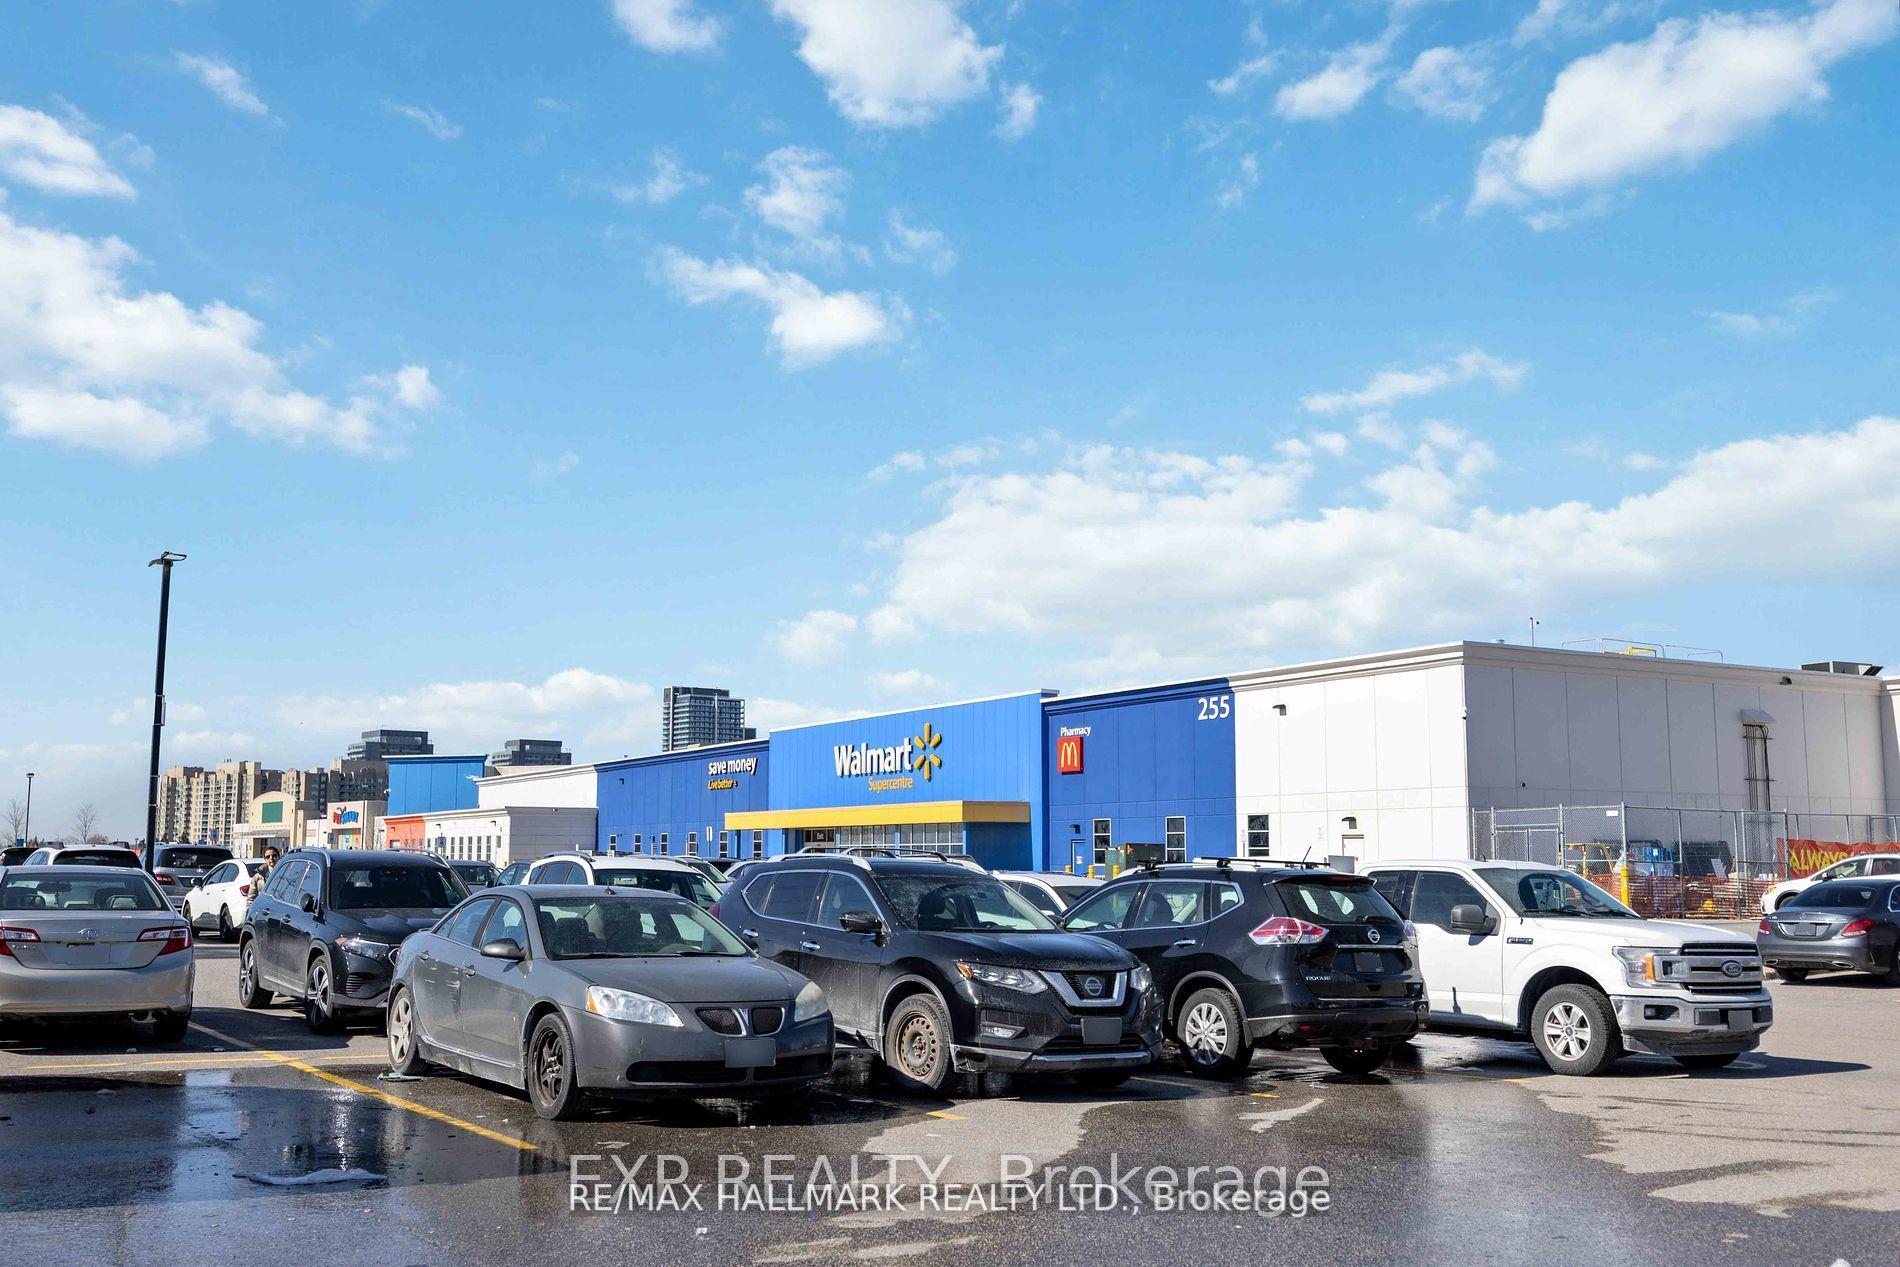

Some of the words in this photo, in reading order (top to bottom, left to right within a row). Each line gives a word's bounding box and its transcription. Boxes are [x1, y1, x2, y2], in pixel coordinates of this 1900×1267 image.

[1198, 695, 1230, 720] 255
[1060, 726, 1092, 737] Pharmacy
[708, 761, 727, 775] save
[727, 757, 757, 775] money
[833, 737, 913, 777] Walmart
[868, 777, 914, 793] Supercentre
